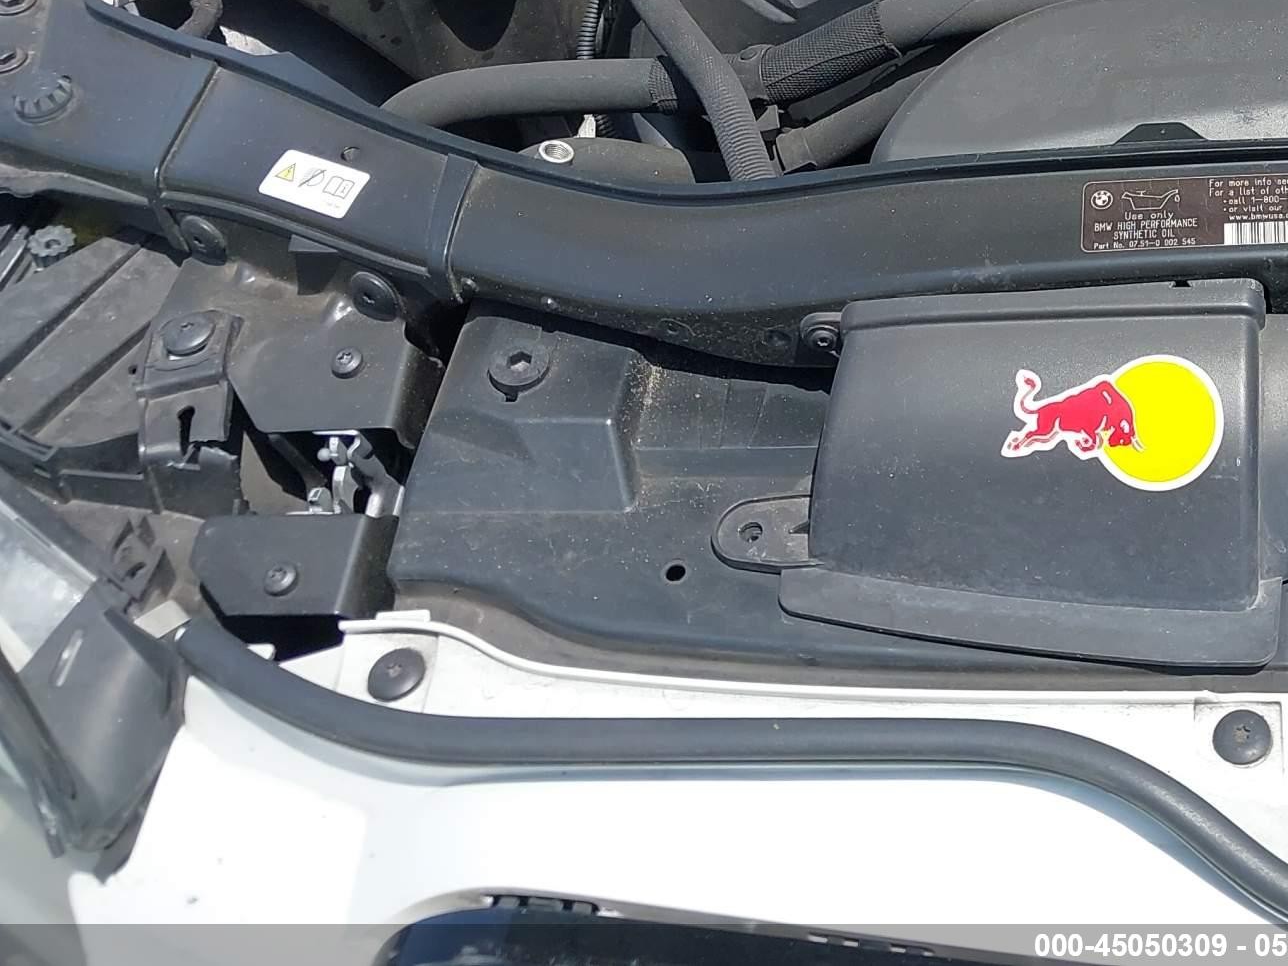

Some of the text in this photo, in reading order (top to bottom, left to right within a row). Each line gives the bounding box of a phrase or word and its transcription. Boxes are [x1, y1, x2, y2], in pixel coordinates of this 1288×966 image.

[1209, 178, 1224, 188] For
[1228, 179, 1250, 187] more
[1254, 176, 1272, 186] info
[1209, 187, 1224, 197] For
[1239, 185, 1255, 196] list
[1260, 185, 1271, 195] of
[1243, 203, 1263, 212] visit
[1268, 204, 1283, 212] our
[1124, 210, 1174, 221] Use only
[1094, 218, 1198, 232] BMW HIGH PERFORMANCE
[1113, 229, 1175, 240] SYNTHETIC OIL
[1093, 242, 1109, 250] Part
[1113, 241, 1125, 249] No.
